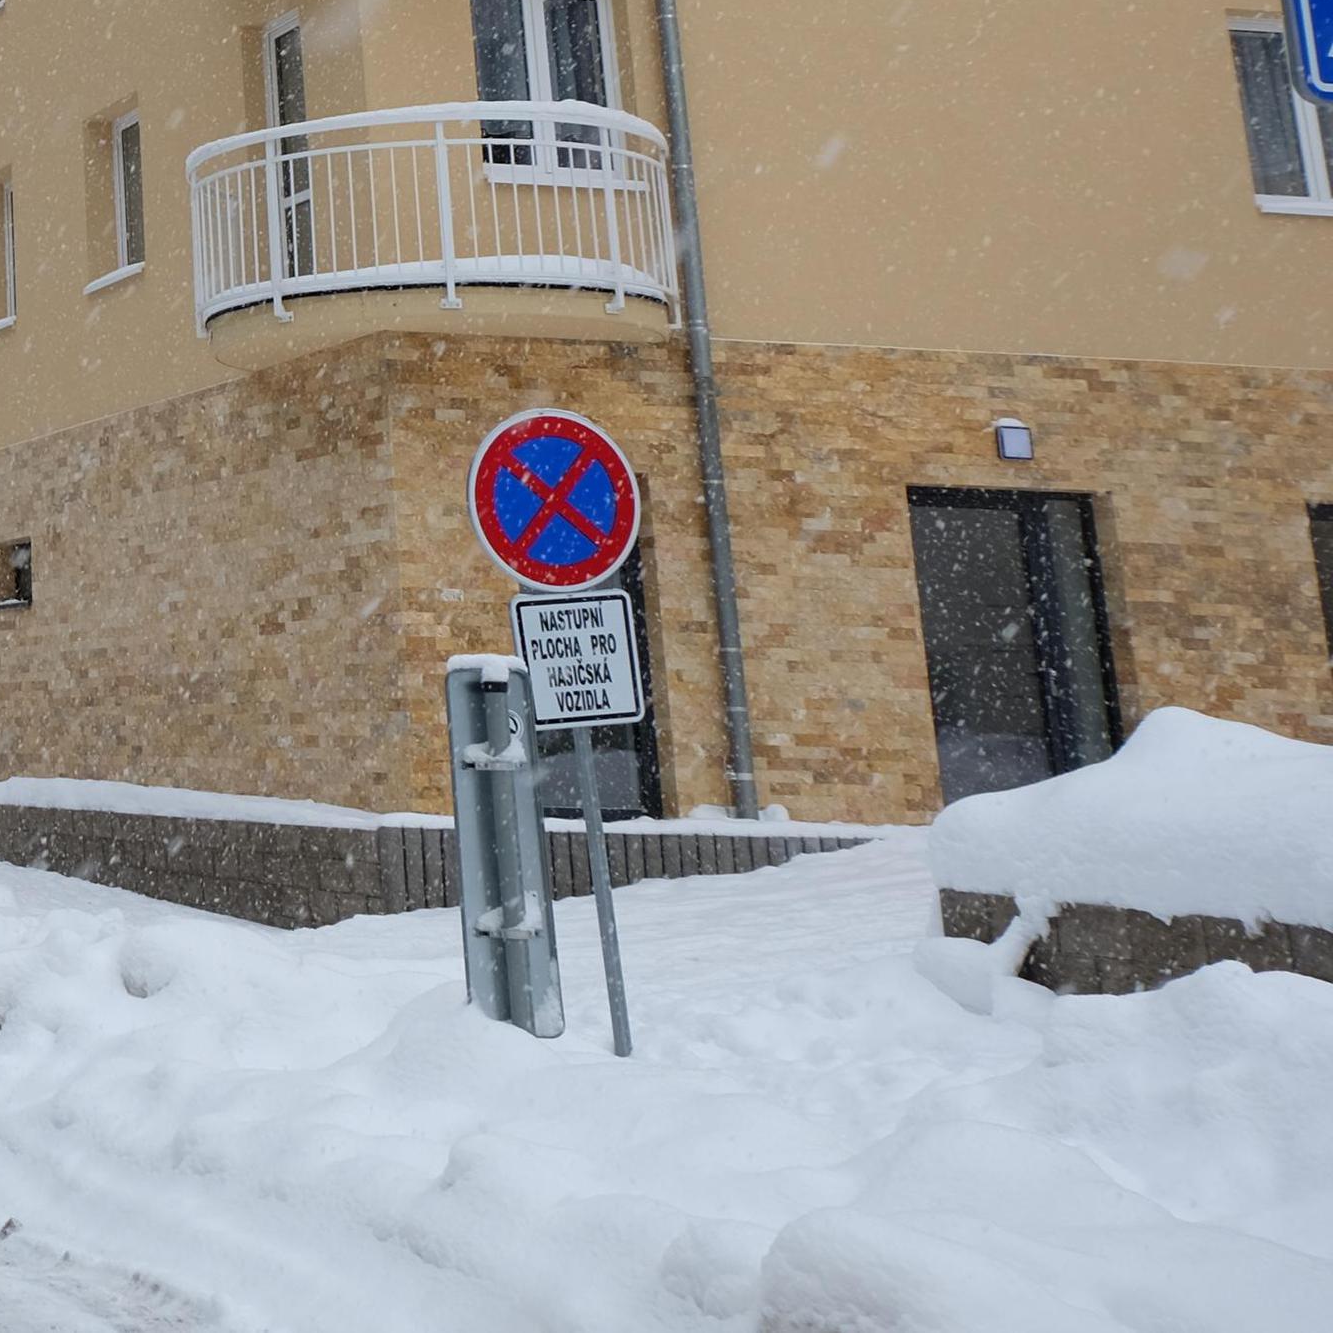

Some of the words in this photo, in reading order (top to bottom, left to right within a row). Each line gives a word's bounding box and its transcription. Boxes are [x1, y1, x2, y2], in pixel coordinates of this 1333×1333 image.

[539, 602, 604, 633] NASTUPNÍ
[531, 636, 583, 660] PLOCHA
[590, 633, 617, 656] PRO
[547, 657, 613, 688] HASIČSKÁ
[555, 688, 611, 713] VOZIDLA
